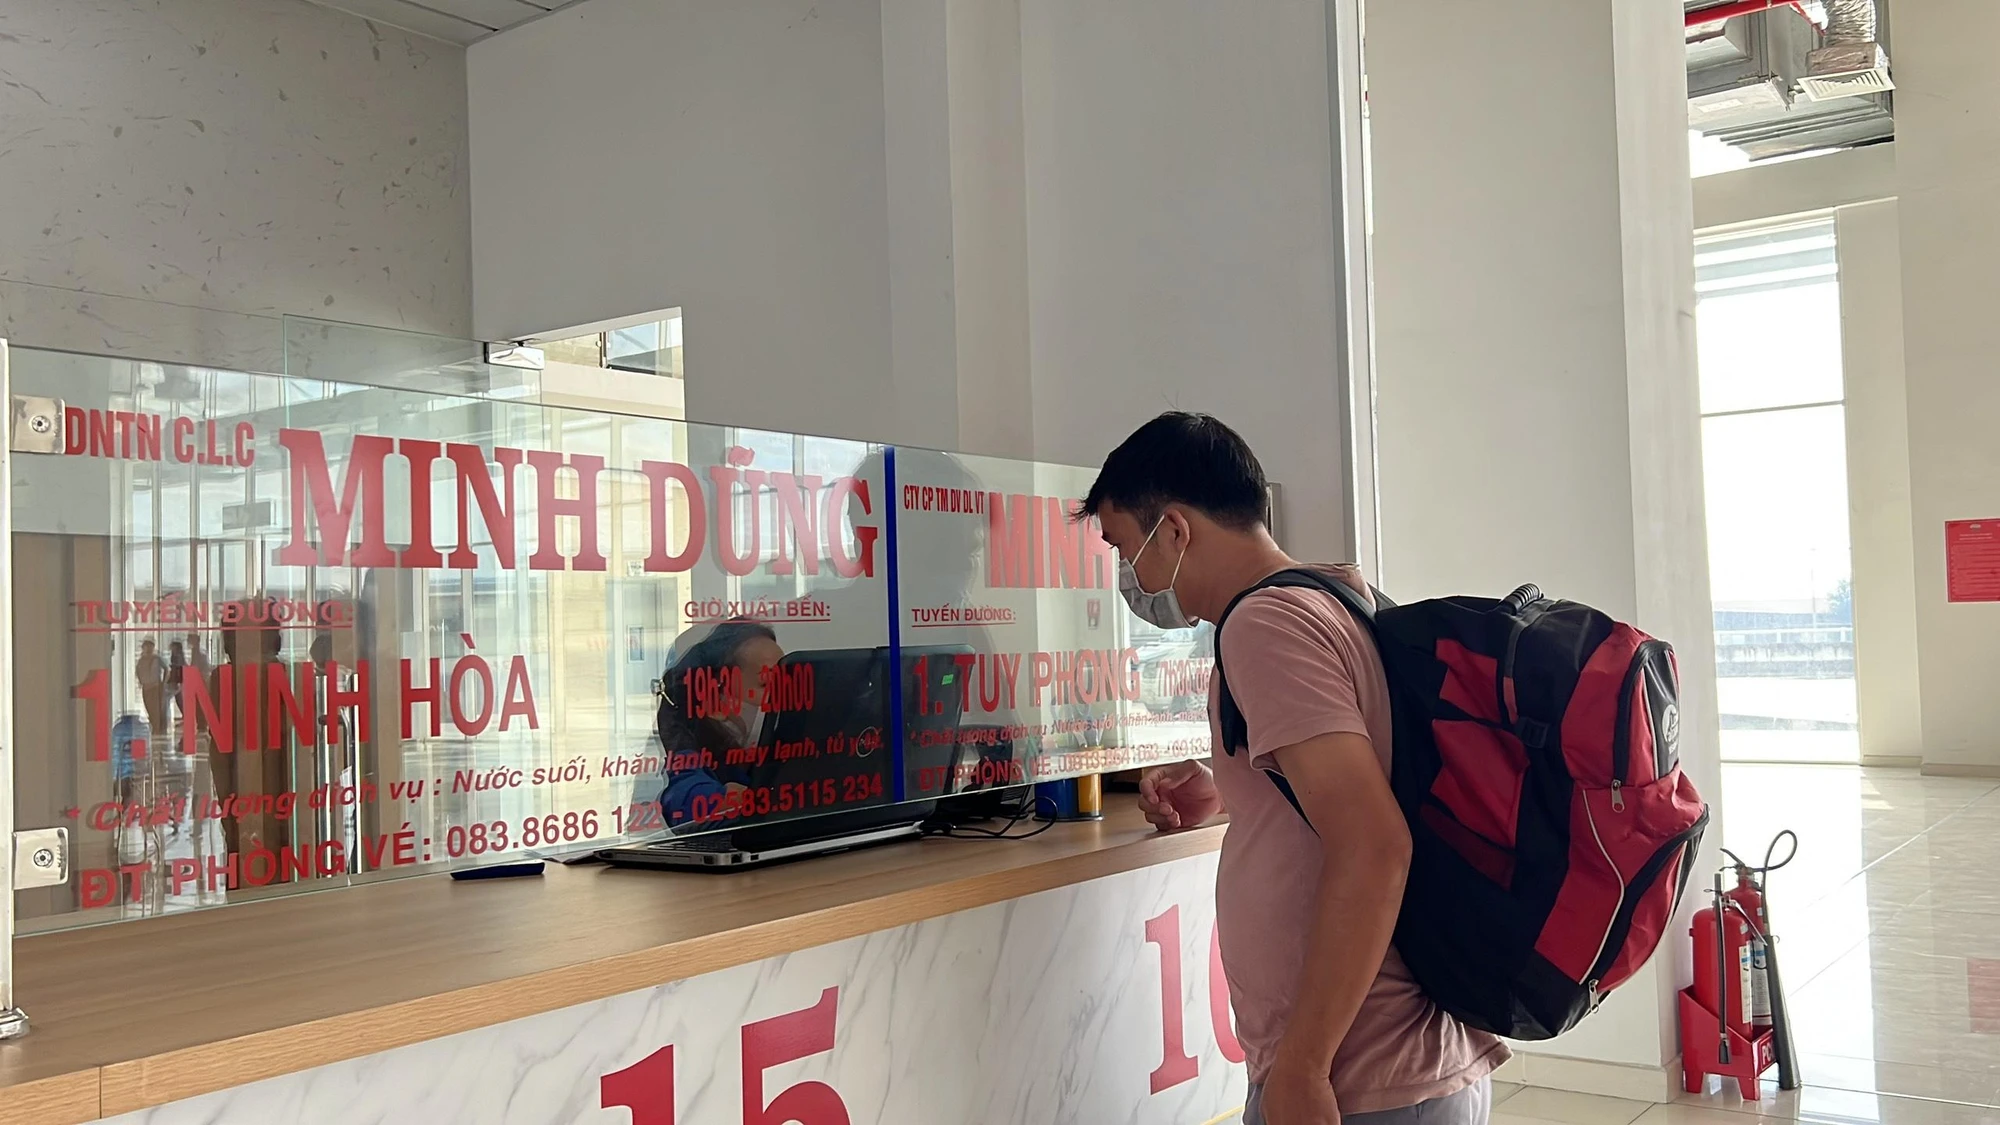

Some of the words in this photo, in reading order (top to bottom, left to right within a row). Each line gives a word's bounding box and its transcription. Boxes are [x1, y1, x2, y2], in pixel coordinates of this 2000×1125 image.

[65, 405, 161, 461] DNTN
[173, 415, 256, 467] C.L.C
[278, 428, 607, 573] MINH
[642, 445, 878, 578] DŨNG
[904, 484, 920, 510] CTY
[922, 486, 934, 511] CP
[935, 487, 949, 512] TM
[950, 488, 961, 513] DV
[963, 489, 974, 514] DL
[975, 490, 985, 514] VT
[989, 491, 1113, 590] MINH
[76, 590, 209, 624] TUYẾN
[684, 596, 725, 618] GIỜ
[728, 594, 781, 617] XUẤT
[786, 594, 831, 617] BẾN:
[911, 603, 961, 623] TUYẾN
[964, 604, 1017, 622] ĐƯỜNG:
[75, 668, 147, 762] 1.
[181, 659, 371, 755] NINH
[400, 633, 540, 739] HÒA
[683, 664, 743, 720] 19h30
[759, 662, 815, 713] 20h00
[912, 654, 944, 716] 1.
[953, 653, 1022, 713] TUY
[1032, 648, 1141, 708] PHONG
[199, 791, 297, 824] lượng
[308, 780, 378, 811] dịch
[389, 779, 424, 799] vụ
[452, 767, 524, 795] Nước
[531, 755, 592, 786] suối,
[601, 751, 659, 778] khăn
[666, 747, 719, 776] lạnh,
[725, 741, 770, 768] máy
[774, 735, 821, 764] lạnh,
[80, 863, 153, 909] ĐT
[172, 839, 346, 896] PHÒNG
[363, 822, 432, 869] VÉ:
[446, 808, 599, 858] 083.8686
[611, 800, 664, 834] 122
[842, 773, 884, 802] 234
